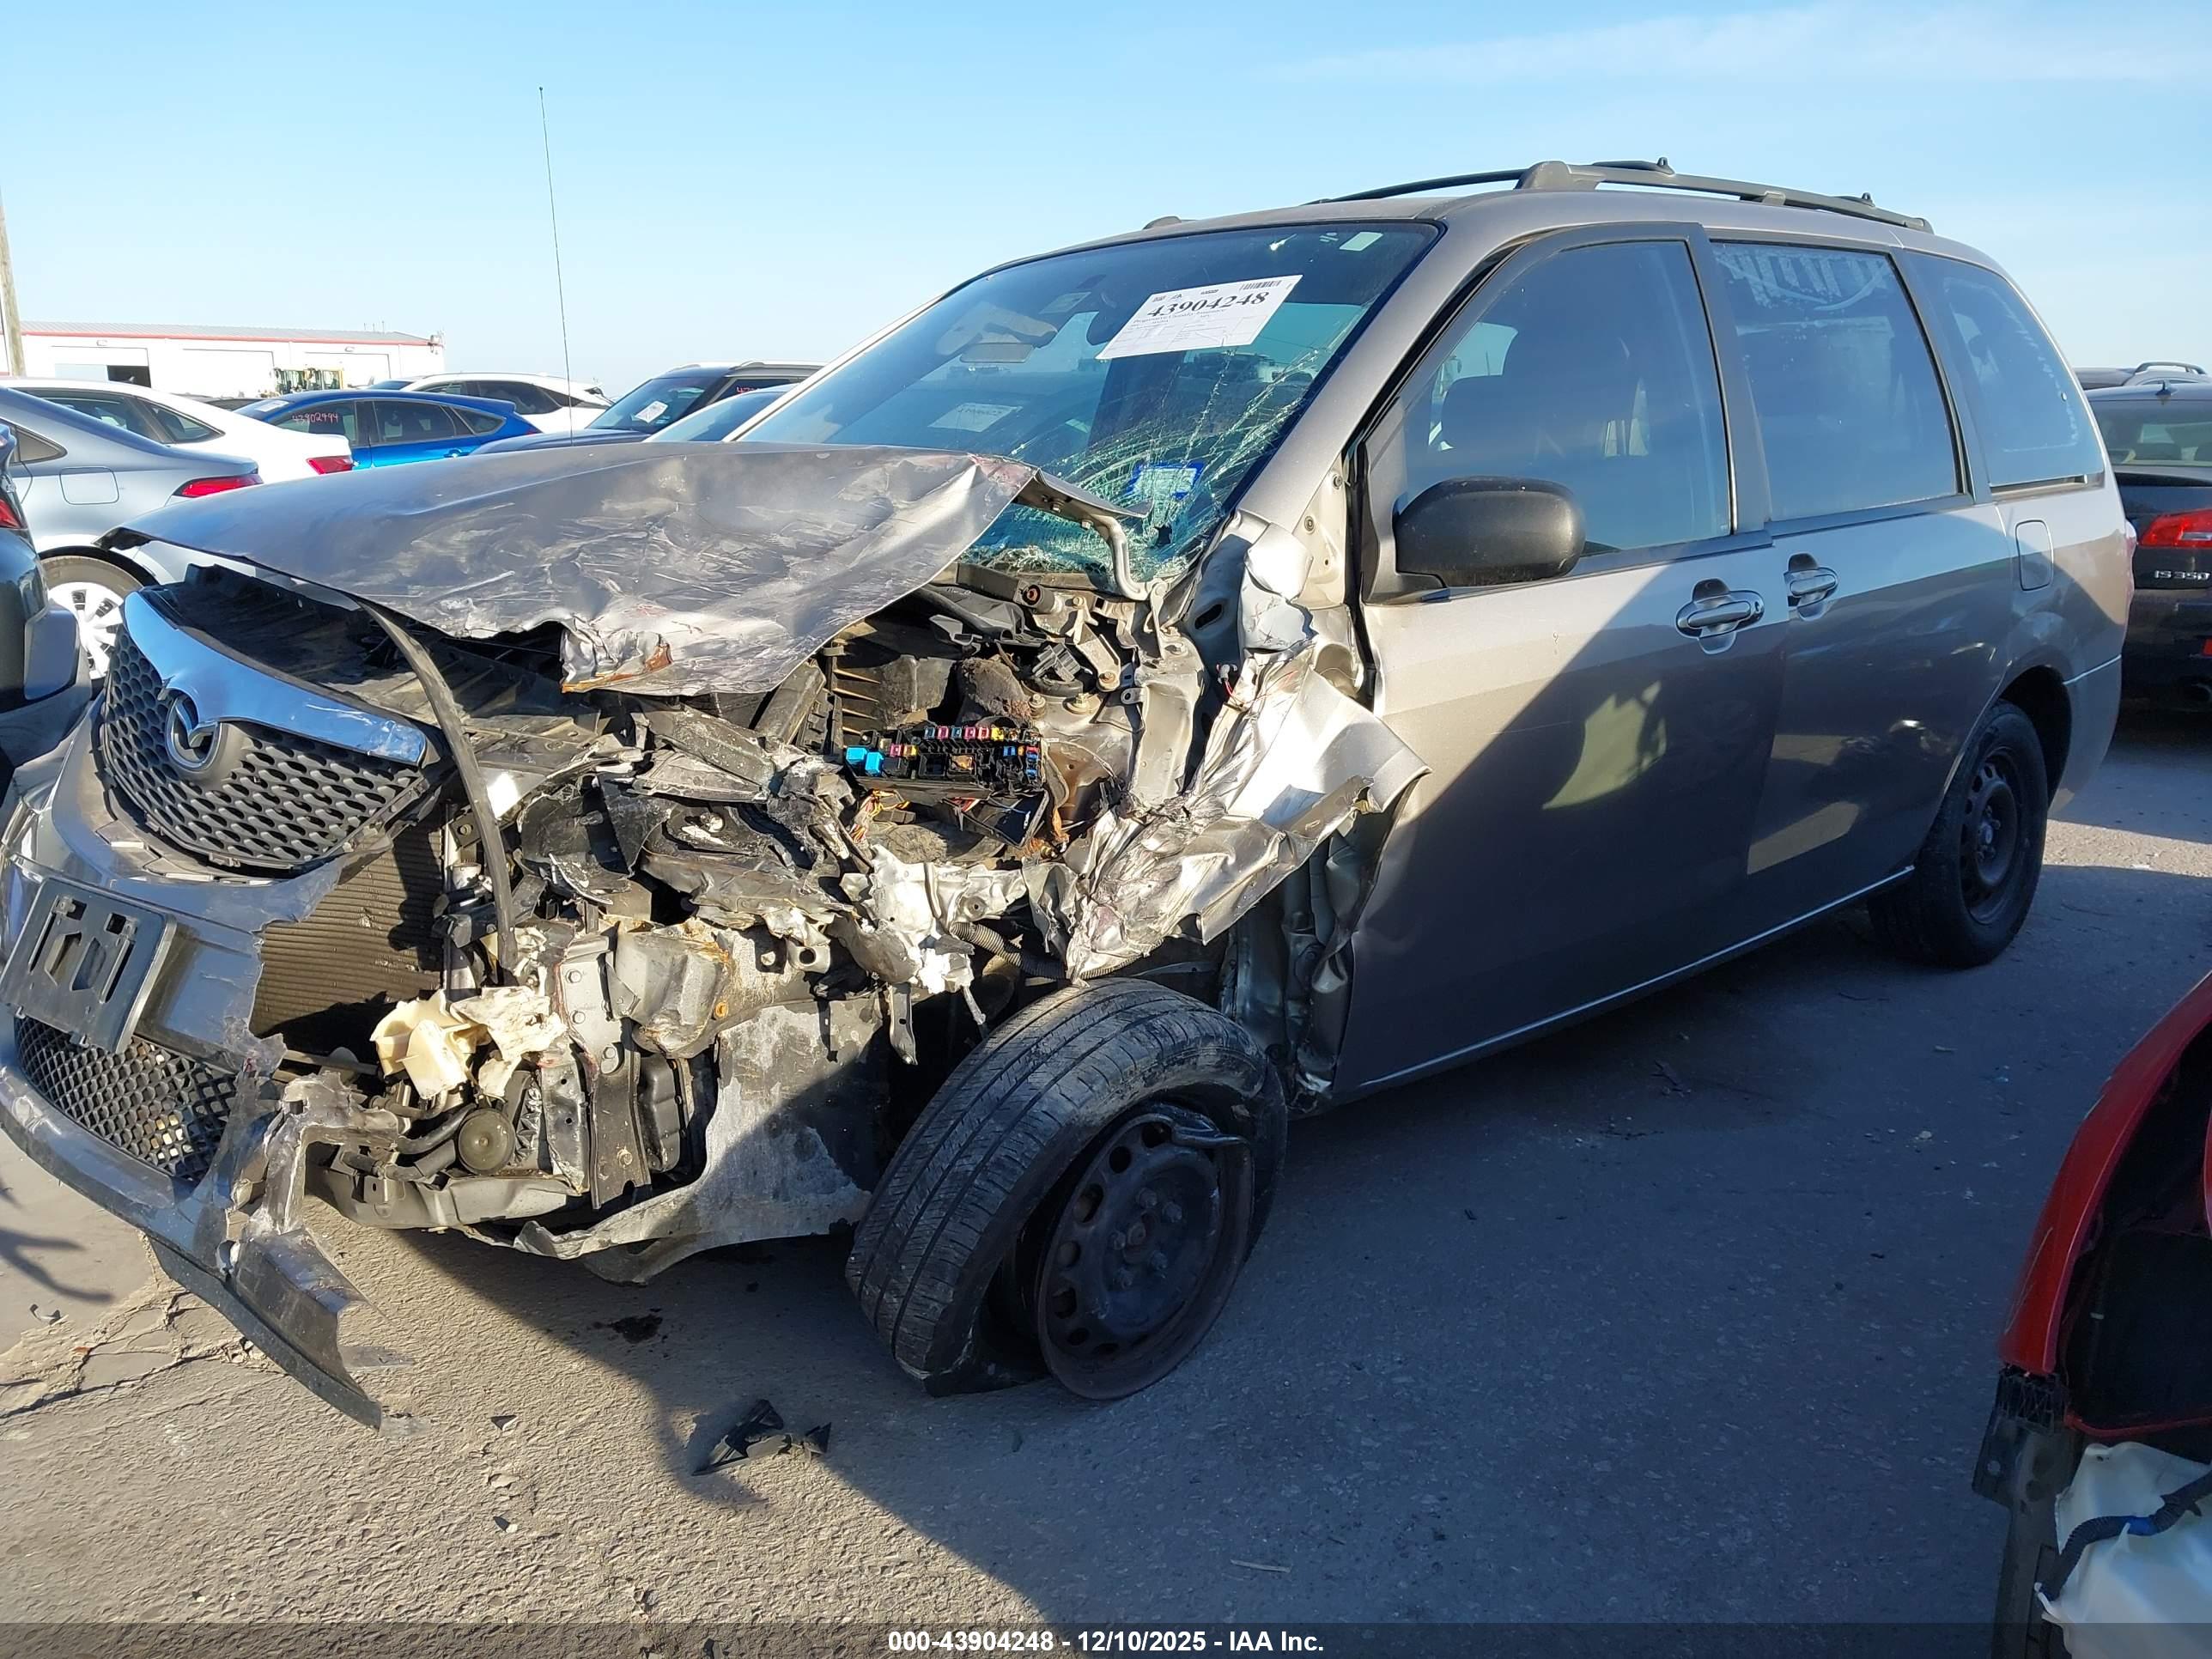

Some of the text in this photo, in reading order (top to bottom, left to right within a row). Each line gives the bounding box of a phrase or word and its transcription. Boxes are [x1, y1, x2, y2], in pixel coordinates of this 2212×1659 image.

[1147, 291, 1269, 317] 43904248
[2154, 570, 2210, 580] IS 350
